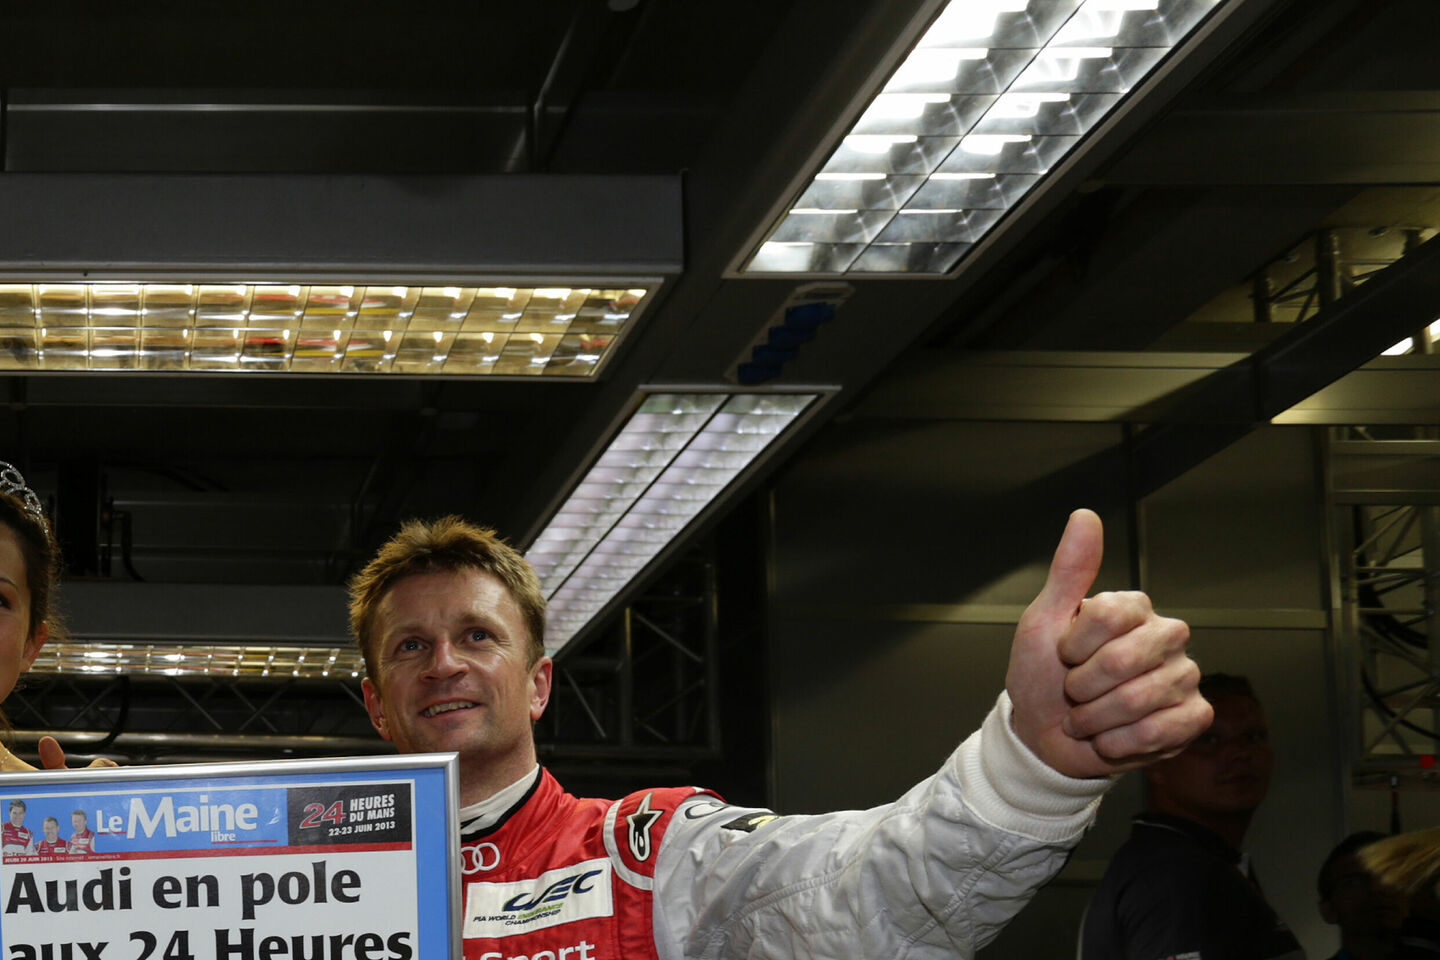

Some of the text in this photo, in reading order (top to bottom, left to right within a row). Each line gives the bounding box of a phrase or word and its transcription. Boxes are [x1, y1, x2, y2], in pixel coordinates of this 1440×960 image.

[349, 793, 395, 813] HEURES
[96, 795, 258, 839] Le Maine
[299, 800, 348, 830] 24
[349, 807, 395, 823] DU MANS
[211, 831, 236, 842] libre
[328, 820, 396, 837] 22-23 JUIN 2013
[4, 860, 362, 921] Audi en pole
[488, 914, 517, 922] WORLD
